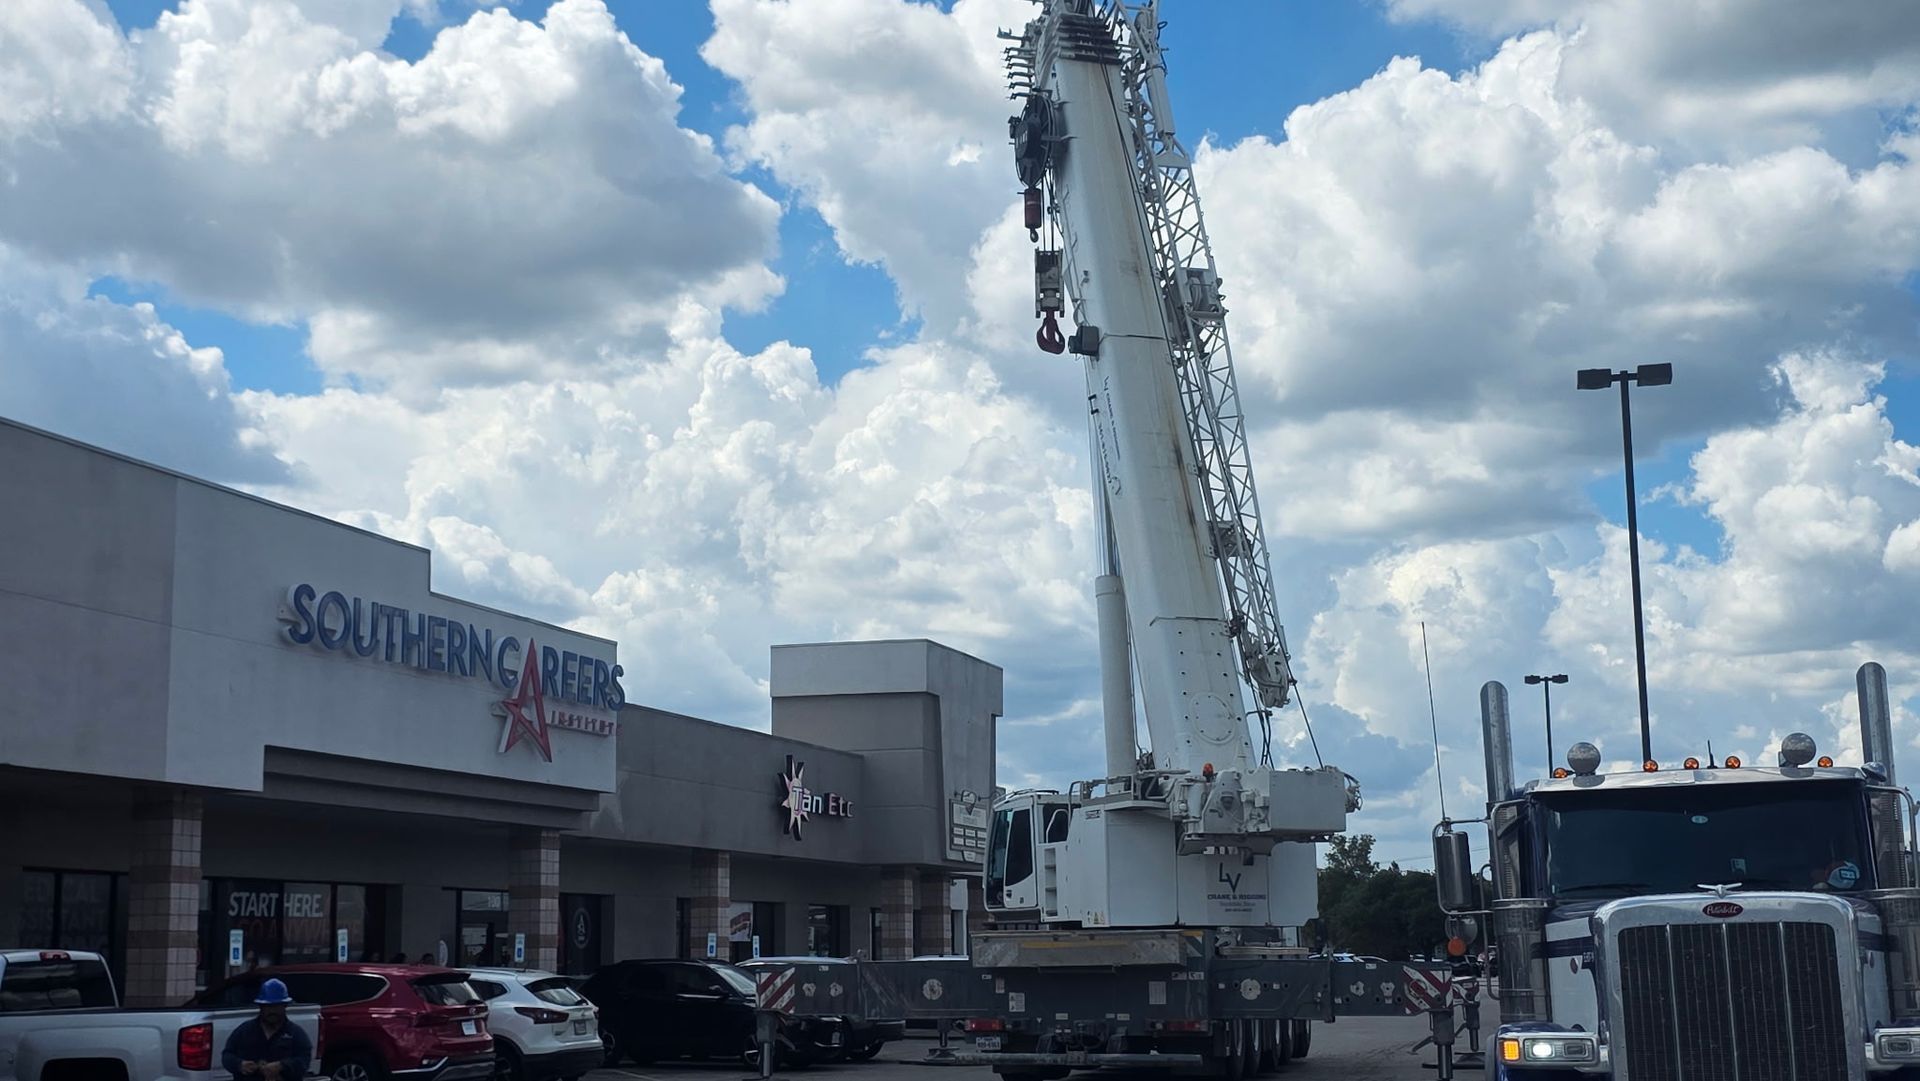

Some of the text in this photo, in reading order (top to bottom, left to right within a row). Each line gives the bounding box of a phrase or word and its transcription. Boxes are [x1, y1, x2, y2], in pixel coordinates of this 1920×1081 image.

[287, 583, 625, 762] SOUTHERN CAREERS
[791, 786, 822, 815] Tan
[228, 891, 324, 918] START HERE.
